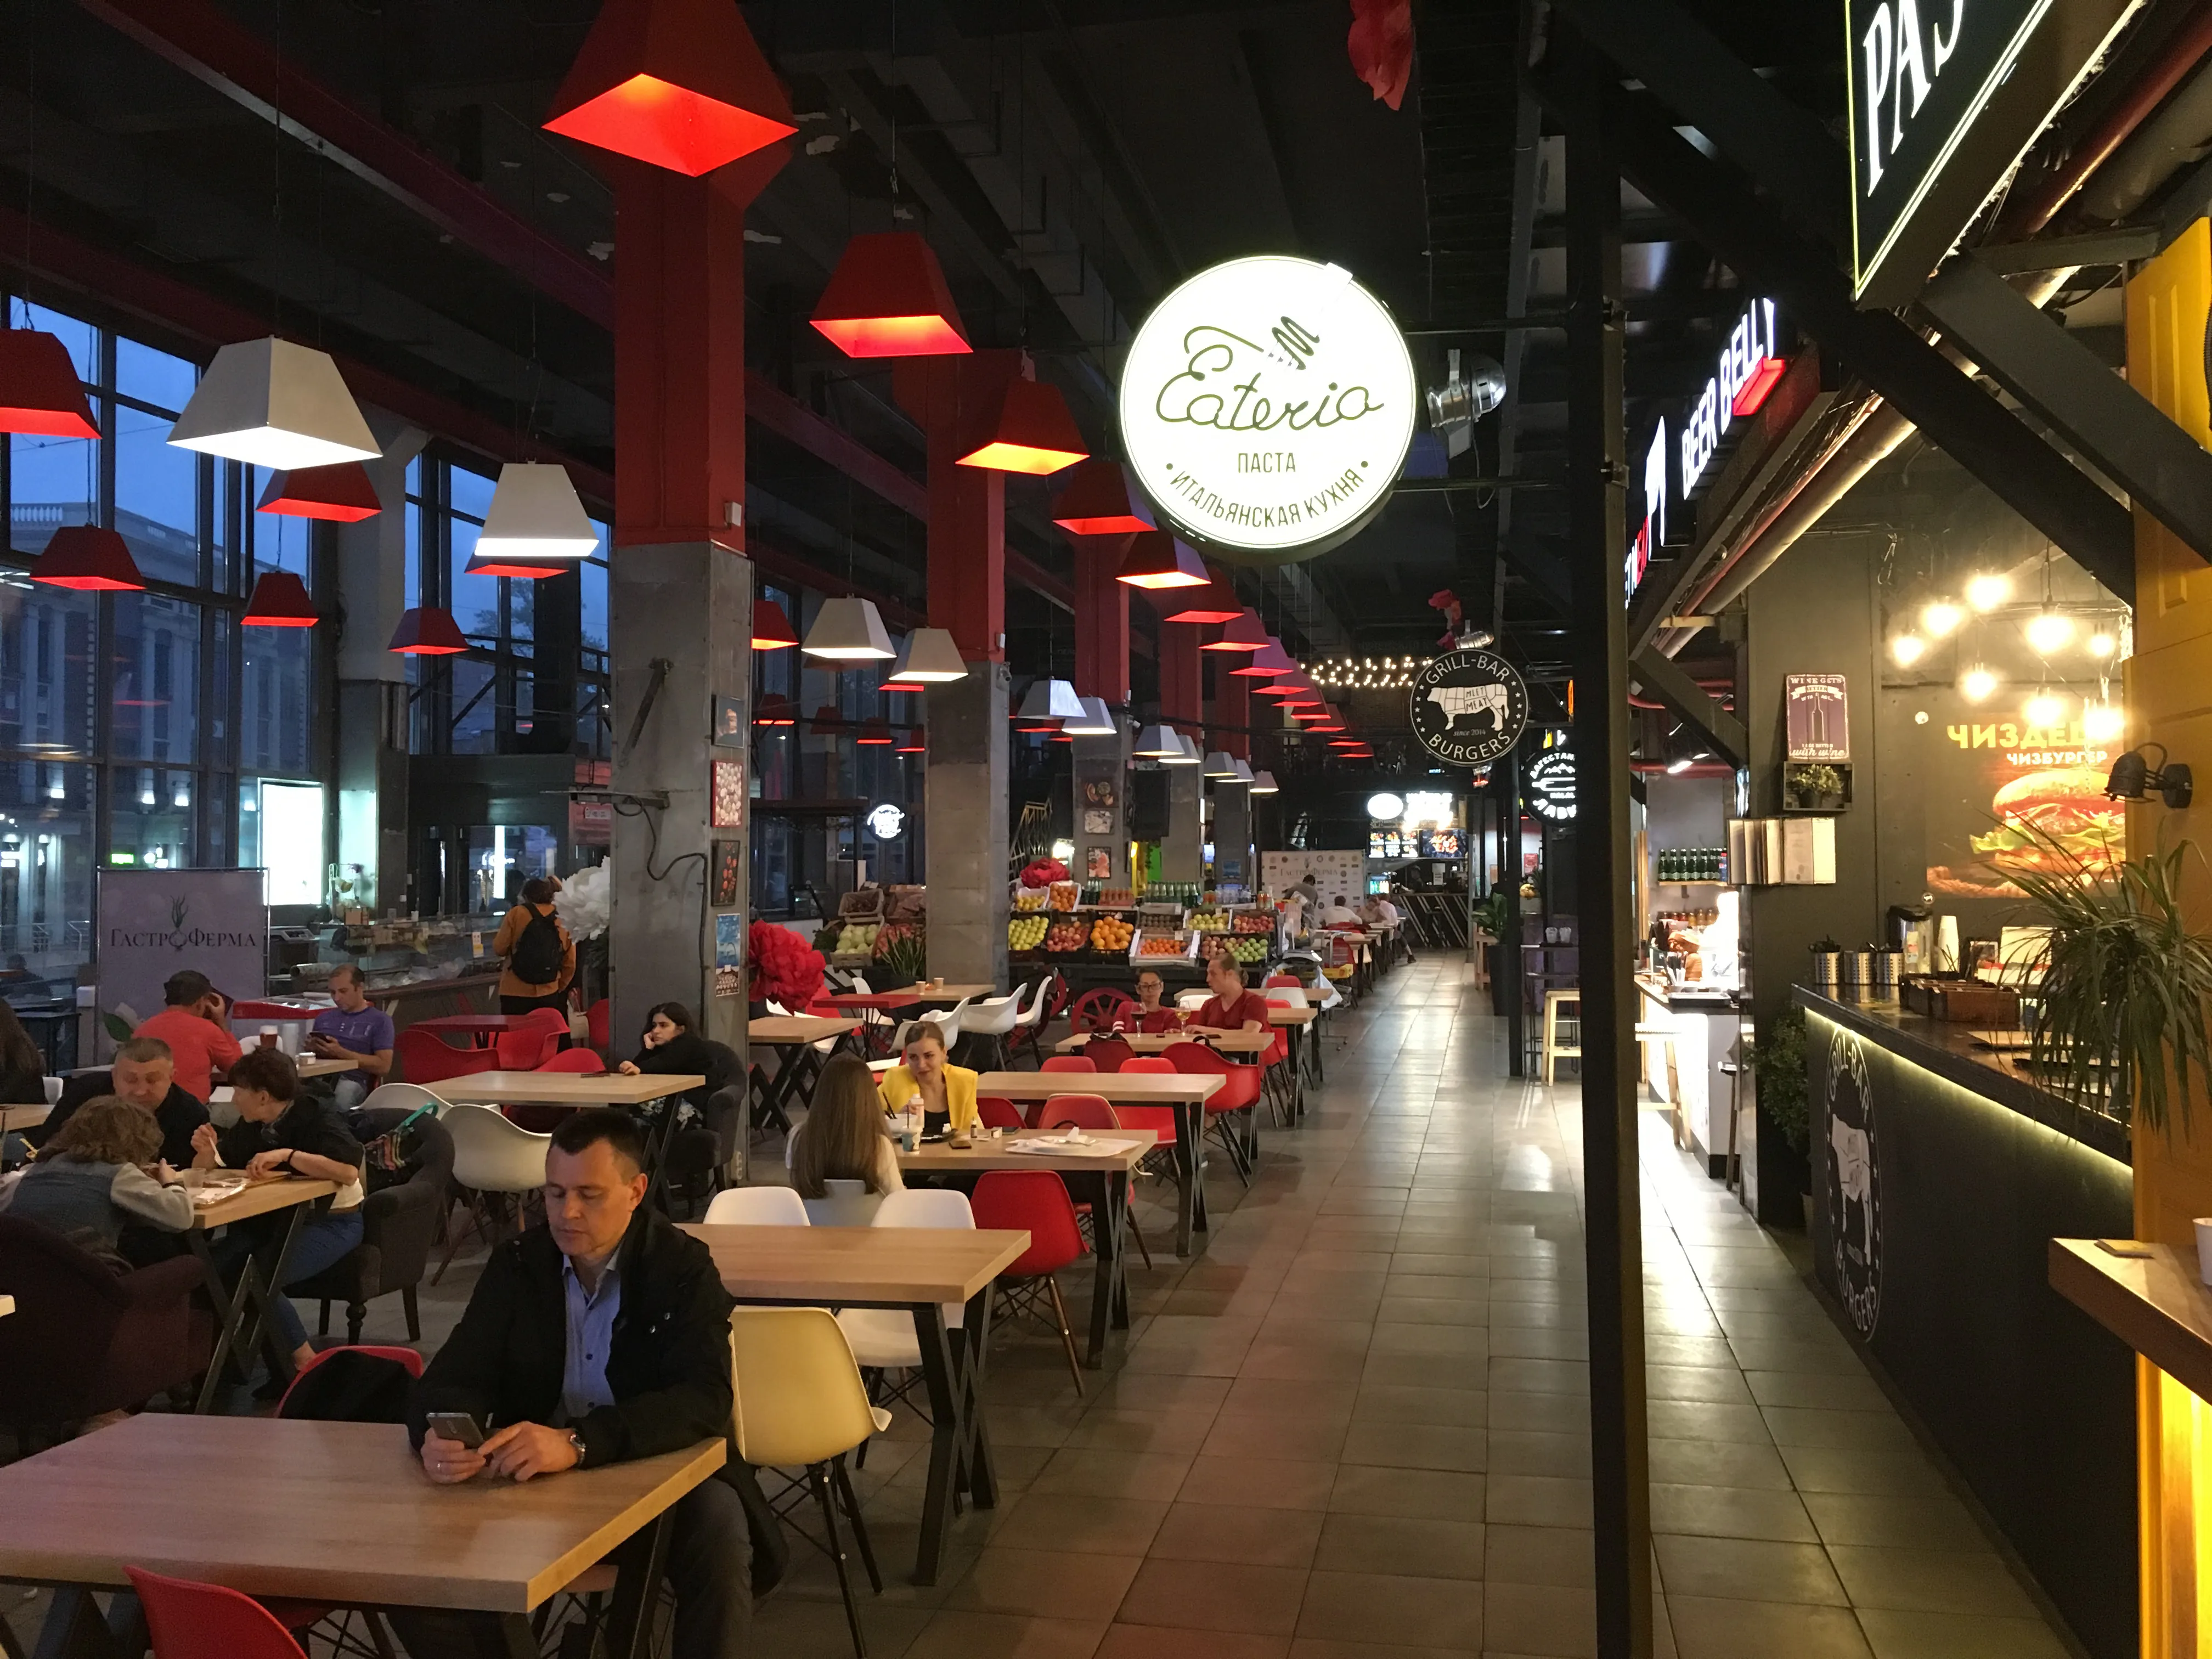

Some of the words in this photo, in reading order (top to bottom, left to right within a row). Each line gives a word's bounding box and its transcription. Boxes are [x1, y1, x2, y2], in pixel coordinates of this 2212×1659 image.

[1156, 344, 1385, 431] Eateria
[1682, 376, 1717, 500] BEER
[1720, 297, 1775, 436] BELLY
[1238, 452, 1296, 473] ПАСТА
[1170, 470, 1301, 528] ИТАЛЬЯНСКАЯ
[1304, 468, 1364, 518] КУХНЯ
[1425, 654, 1510, 685] GRILL-BAR
[1466, 687, 1483, 698] MEET
[1466, 697, 1487, 712] MEAT
[1428, 731, 1510, 760] BURGERS
[2006, 750, 2108, 765] ЧИЗБУРГЕР
[1530, 753, 1575, 779] ДАГЕСТАН
[1829, 1034, 1869, 1125] GRILL-BAR
[1837, 1239, 1877, 1331] BURGERS
